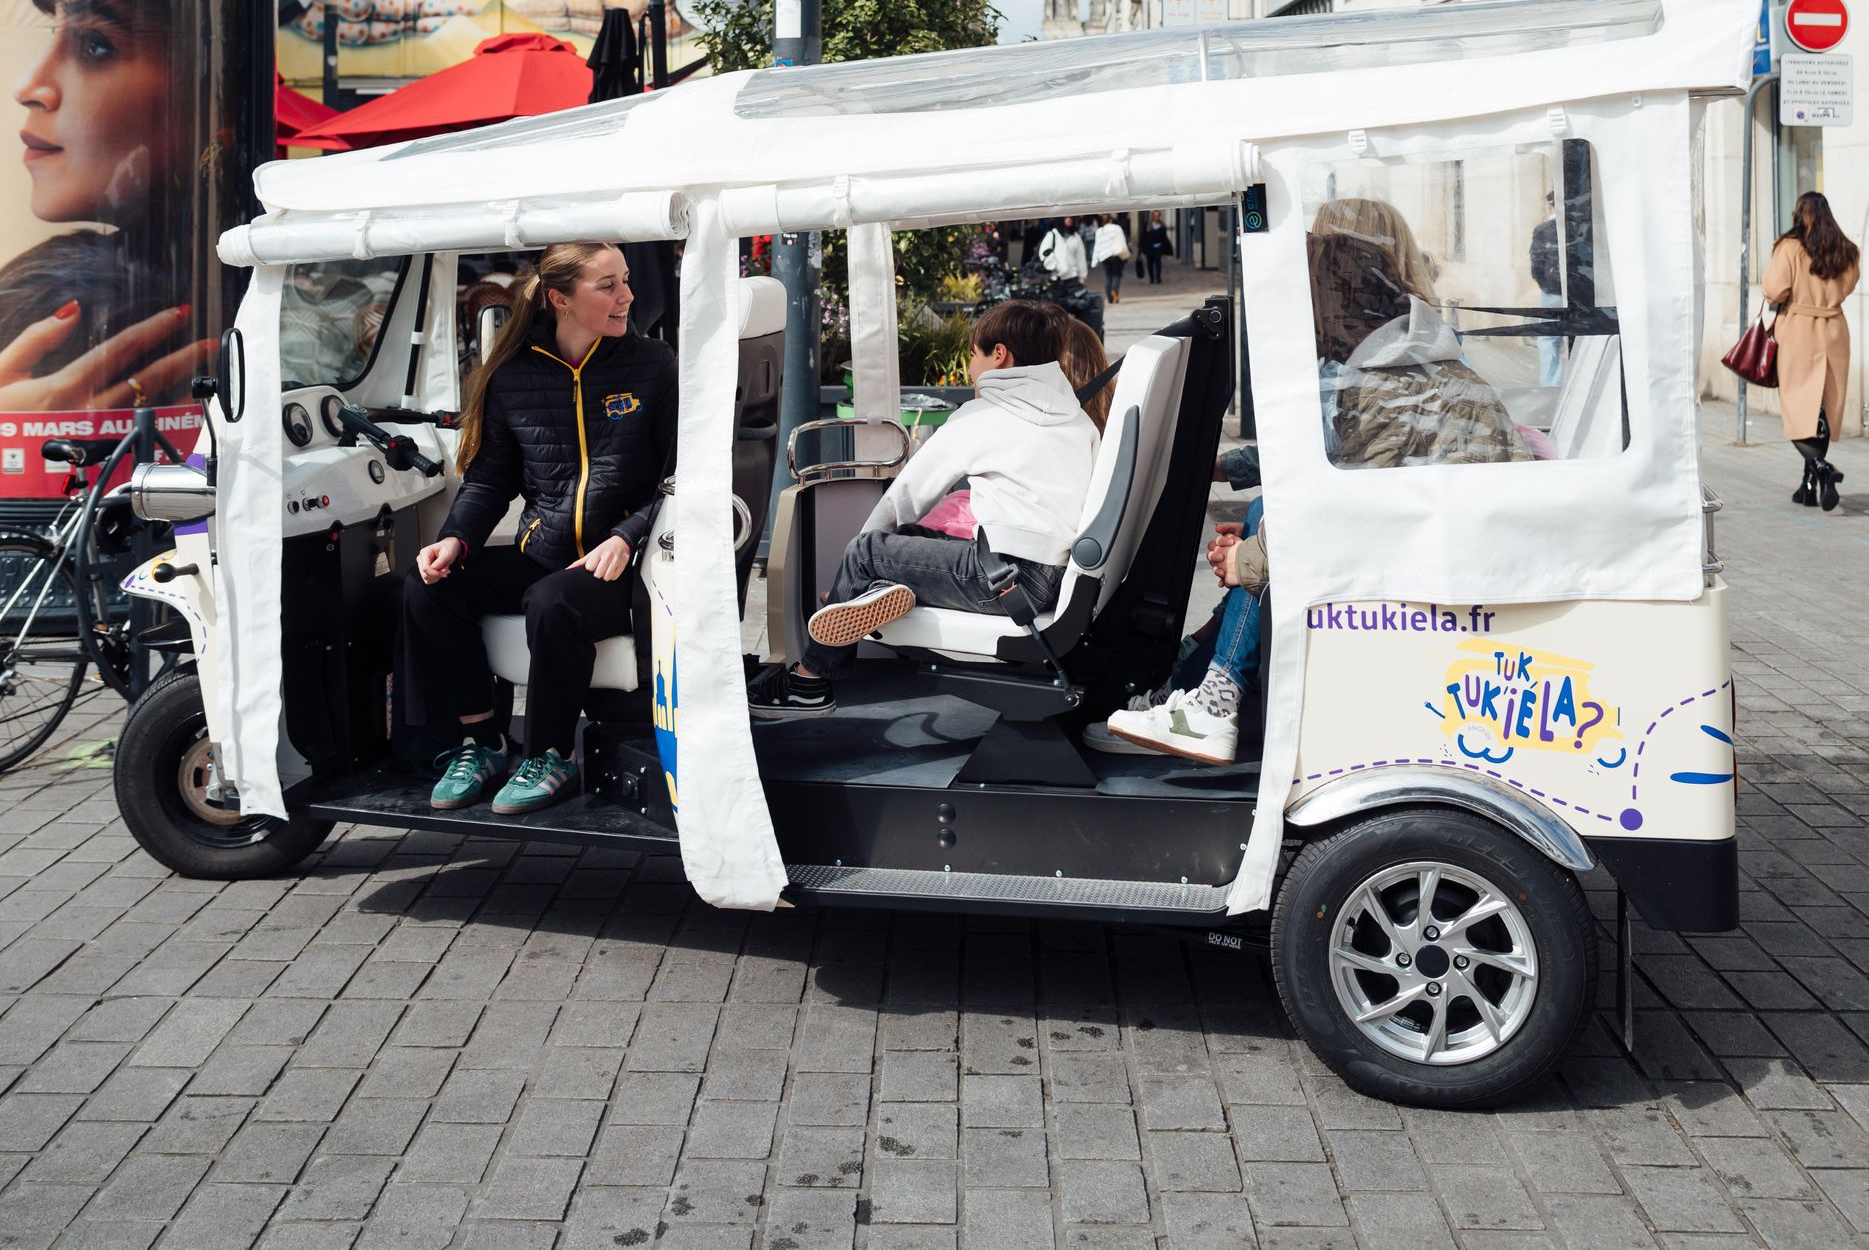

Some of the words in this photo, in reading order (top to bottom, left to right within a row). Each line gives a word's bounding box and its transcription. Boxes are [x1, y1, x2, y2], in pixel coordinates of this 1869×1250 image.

[0, 421, 17, 438] 9
[22, 420, 94, 438] MARS
[98, 418, 133, 435] AU
[154, 411, 208, 431] INÉM
[1306, 602, 1496, 633] uktukiela.fr
[1494, 651, 1533, 682] TUK
[1208, 932, 1222, 942] DO
[1223, 935, 1243, 946] NOT
